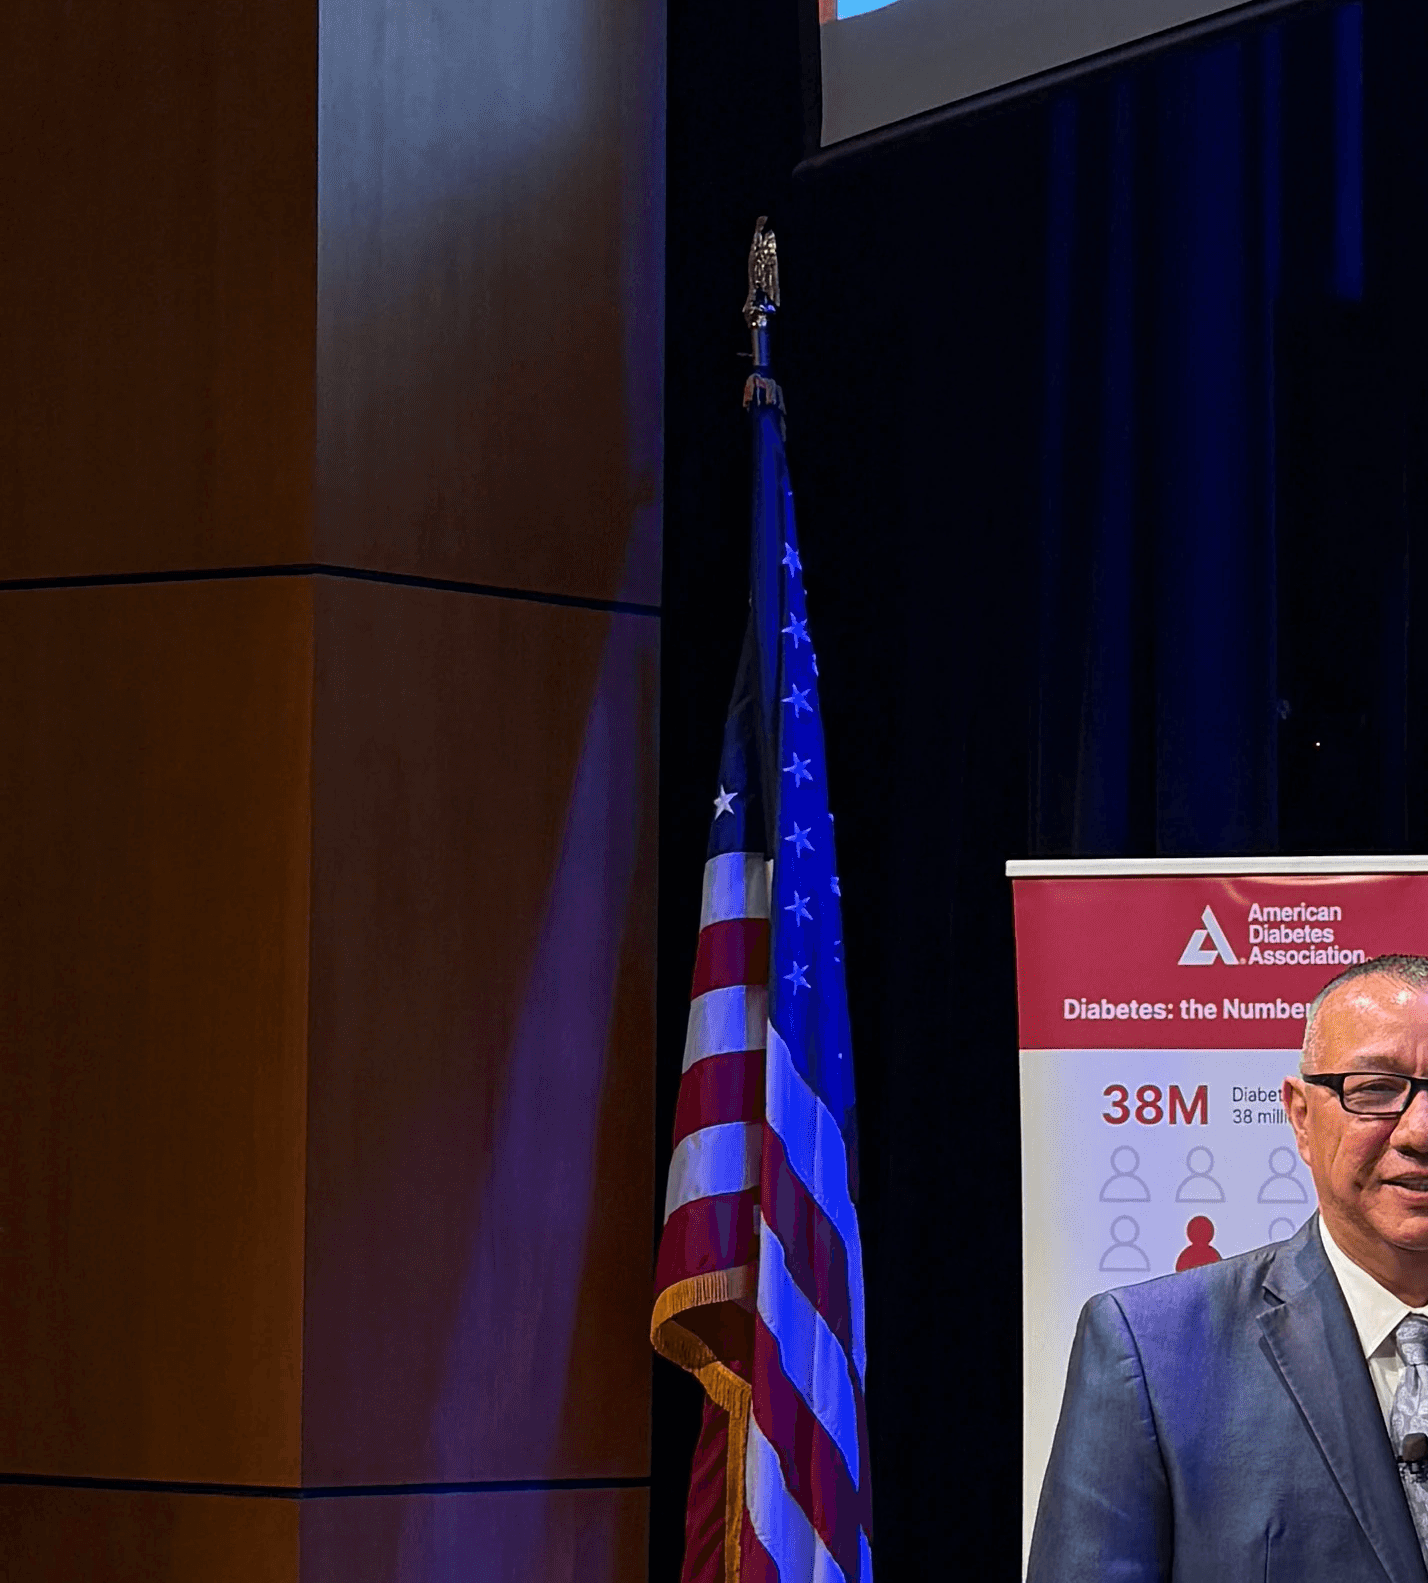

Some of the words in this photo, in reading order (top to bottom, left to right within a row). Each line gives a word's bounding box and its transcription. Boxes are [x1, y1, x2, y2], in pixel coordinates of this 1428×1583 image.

[1248, 902, 1342, 921] American
[1249, 924, 1335, 944] Diabetes
[1248, 945, 1365, 965] Association
[1063, 998, 1174, 1020] Diabetes:
[1180, 998, 1217, 1020] the
[1102, 1084, 1209, 1125] 38M
[1233, 1109, 1253, 1124] 38
